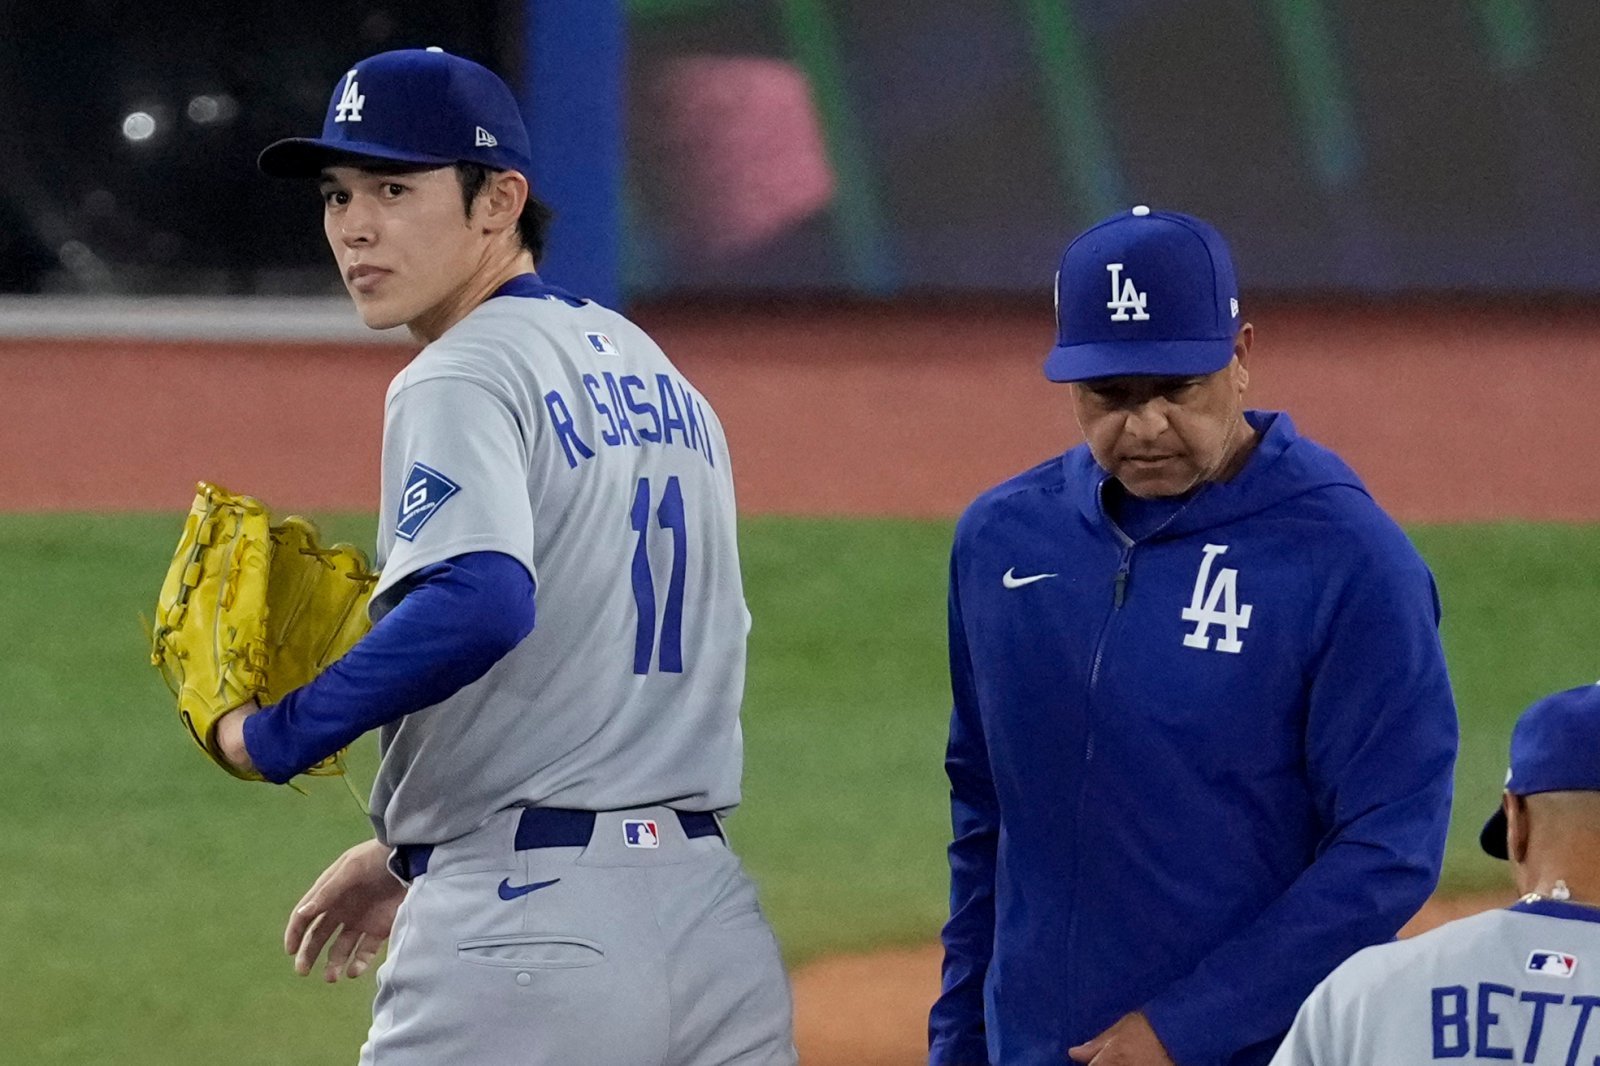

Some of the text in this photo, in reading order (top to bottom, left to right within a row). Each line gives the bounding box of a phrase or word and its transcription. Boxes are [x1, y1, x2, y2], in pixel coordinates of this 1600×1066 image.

[335, 69, 365, 122] LA
[1107, 263, 1150, 321] LA
[544, 371, 714, 469] R SASAKI
[630, 475, 687, 675] 11
[1181, 543, 1253, 654] LA
[1431, 982, 1600, 1066] BETT
